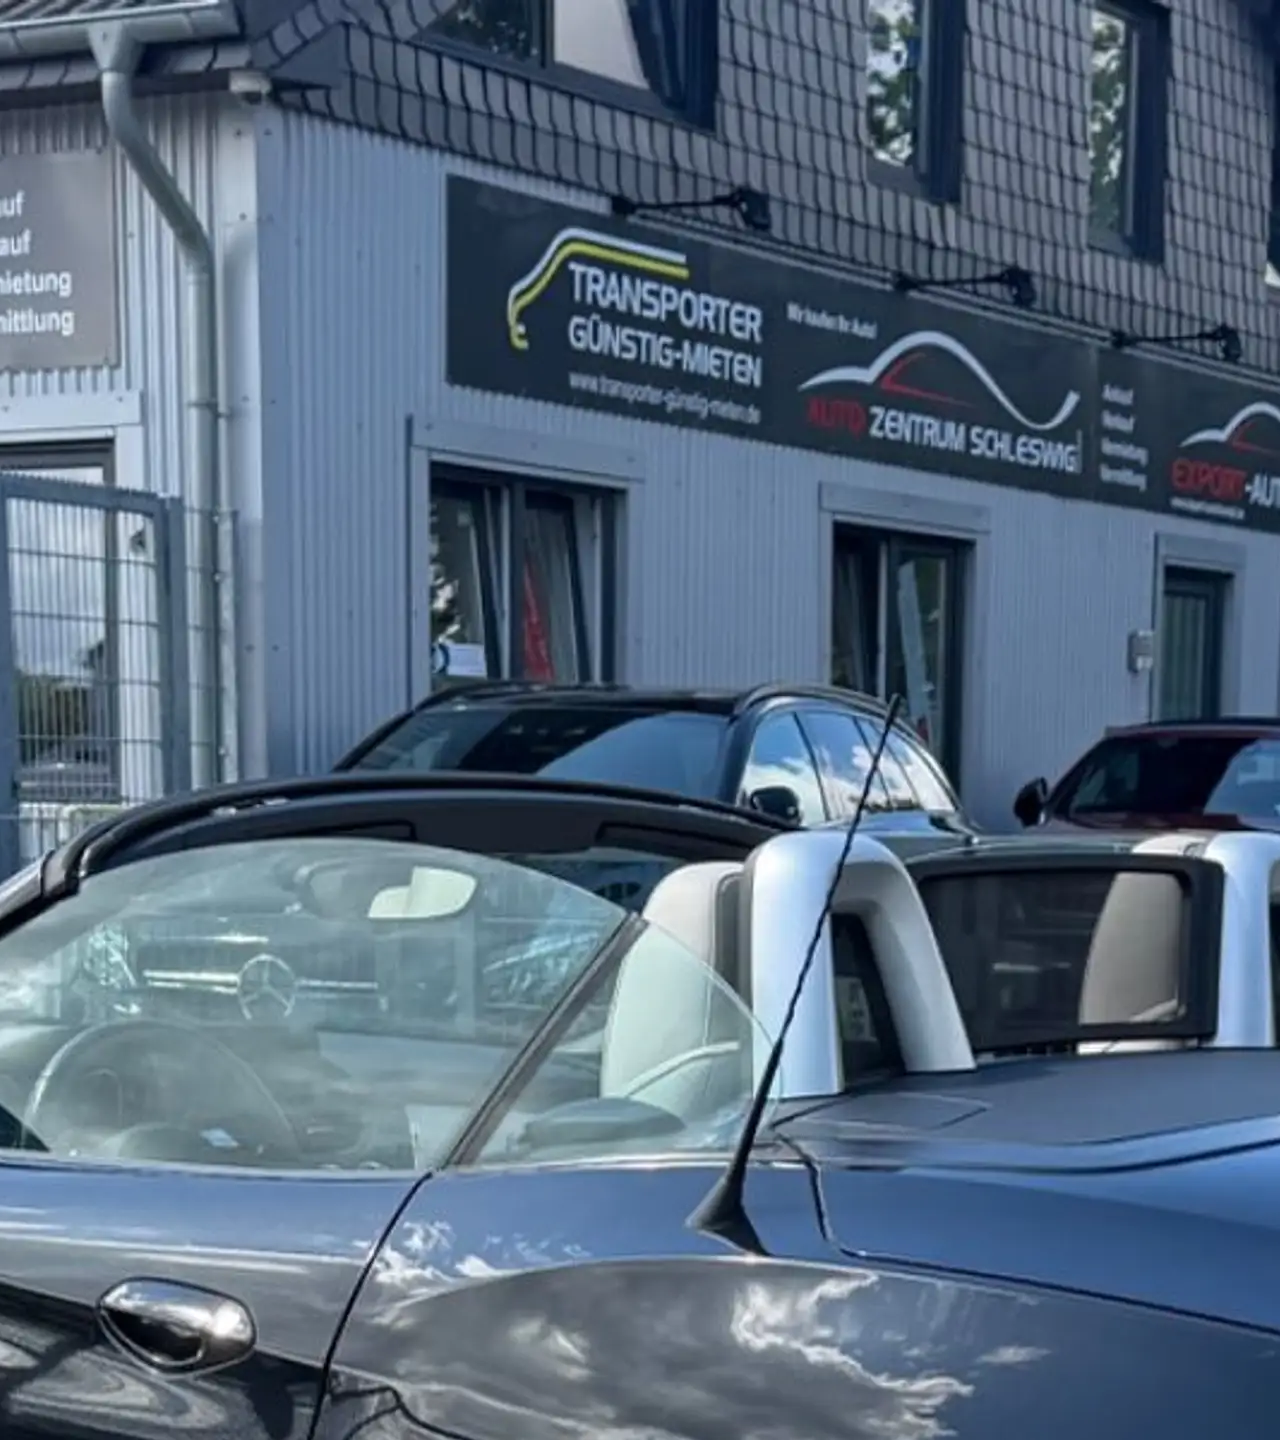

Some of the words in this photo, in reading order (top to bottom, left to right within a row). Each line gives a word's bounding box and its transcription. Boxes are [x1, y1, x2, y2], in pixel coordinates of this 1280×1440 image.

[568, 261, 763, 344] TRANSPORTER
[568, 312, 763, 388] GÜNSTIG-MIETEN
[869, 404, 966, 451] ZENTRUM
[969, 425, 1077, 473] SCHLESWIG
